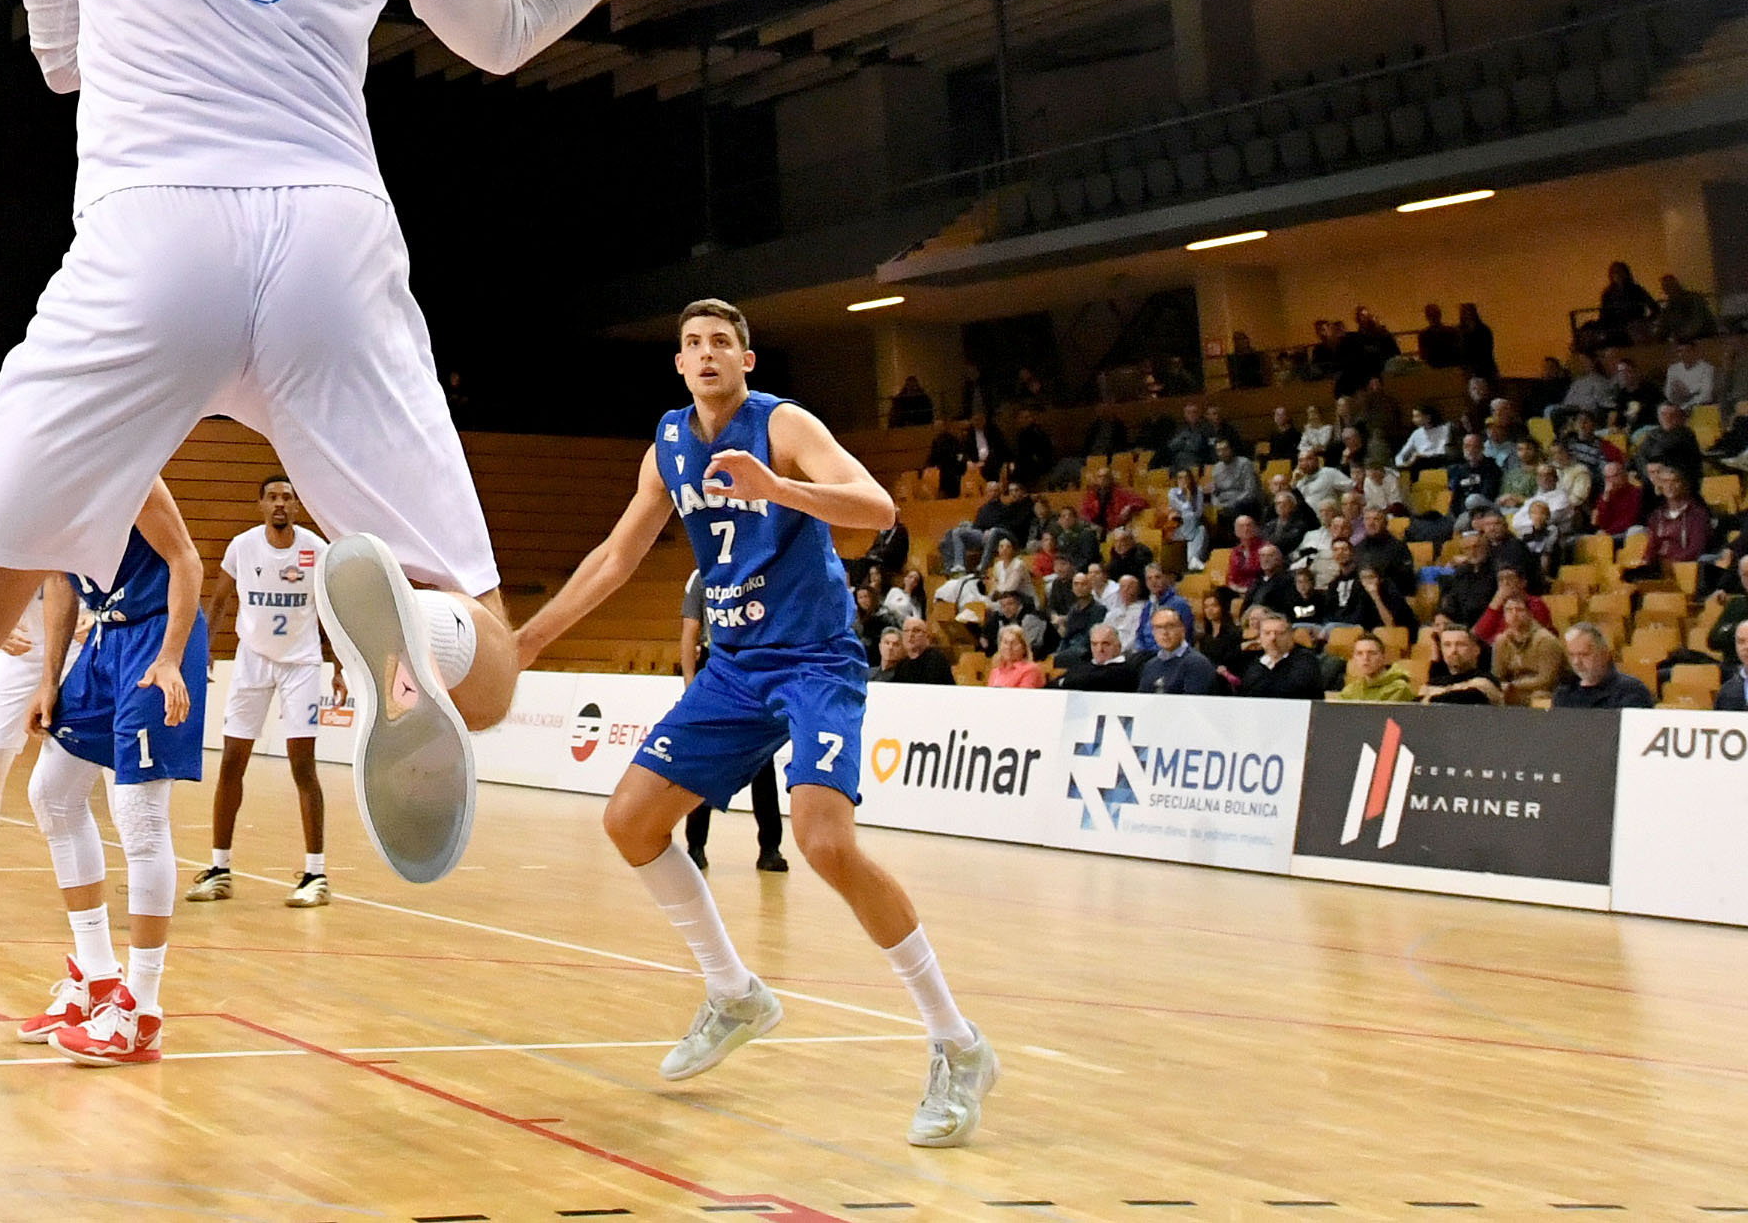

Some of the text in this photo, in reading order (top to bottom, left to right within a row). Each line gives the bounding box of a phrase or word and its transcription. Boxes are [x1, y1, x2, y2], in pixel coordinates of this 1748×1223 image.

[710, 521, 736, 564] 7
[273, 614, 287, 635] 2
[308, 704, 318, 725] 2
[137, 728, 153, 768] 1
[815, 732, 843, 772] 7
[1641, 727, 1747, 761] AUTO
[903, 729, 1040, 796] mlinar
[1152, 747, 1284, 795] MEDICO
[1414, 765, 1562, 783] CERAMICHE
[1149, 794, 1279, 817] SPECIJALNA BOLNICA
[1410, 794, 1541, 819] MARINER
